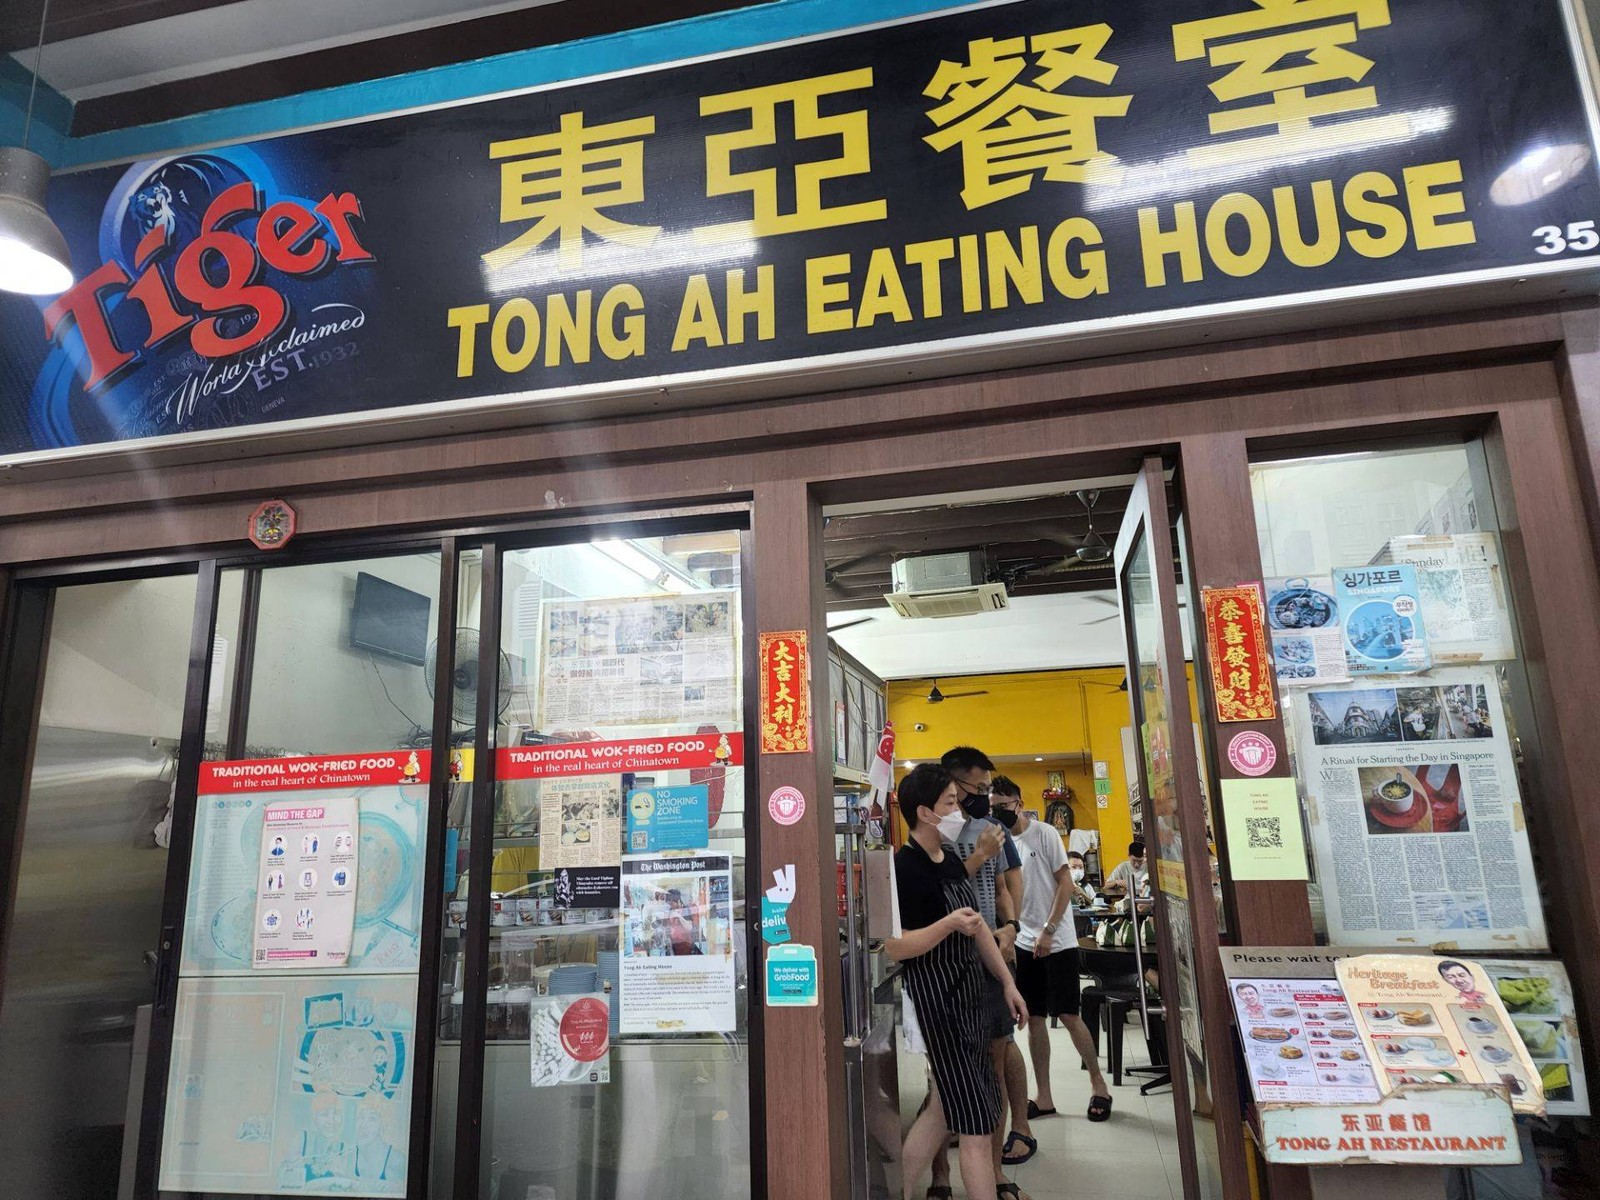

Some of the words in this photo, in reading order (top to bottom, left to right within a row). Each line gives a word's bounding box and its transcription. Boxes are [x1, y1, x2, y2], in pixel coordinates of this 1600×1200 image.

[480, 0, 1392, 271] 東亞餐室
[1531, 220, 1600, 256] 35
[447, 282, 646, 378] TONG
[671, 265, 776, 352] AH
[806, 217, 1110, 335] EATING
[1137, 160, 1477, 287] HOUSE
[44, 181, 375, 392] Tiger
[1342, 570, 1403, 588] 싱가포르
[1218, 598, 1251, 691] 恭喜發財
[772, 640, 795, 725] 大吉大利
[510, 751, 588, 763] TRADITIONAL
[592, 745, 663, 758] WOK-FRIED
[667, 741, 705, 752] FOOD
[1330, 756, 1355, 765] Ritual
[1357, 756, 1368, 764] for
[1370, 754, 1404, 765] Starting
[1405, 754, 1419, 762] the
[1421, 753, 1438, 763] Day
[1450, 752, 1494, 762] Singapore
[213, 765, 285, 777] TRADITIONAL
[289, 760, 356, 773] WOK-FRIED
[360, 758, 395, 769] FOOD
[533, 765, 543, 773] in
[546, 763, 560, 772] the
[563, 762, 582, 771] real
[584, 761, 609, 770] heart
[612, 760, 622, 768] of
[625, 757, 679, 768] Chinatown
[233, 780, 242, 788] in
[244, 777, 258, 787] the
[260, 776, 278, 786] real
[281, 776, 304, 785] heart
[306, 775, 316, 783] of
[320, 774, 370, 783] Chinatown
[657, 790, 670, 799] NO
[657, 797, 698, 807] SMOKING
[267, 811, 289, 820] MIND
[290, 810, 305, 819] THE
[306, 809, 323, 818] GAP
[657, 807, 681, 816] ZONE
[640, 862, 651, 871] The
[653, 861, 690, 872] Washington
[692, 860, 705, 869] Post
[1233, 954, 1285, 963] Please
[1287, 954, 1319, 963] wait
[774, 973, 809, 982] GrabFood
[1348, 967, 1408, 982] Heritage
[1370, 979, 1440, 990] Breakfast
[1341, 1113, 1432, 1132] 东亚餐馆
[1276, 1135, 1331, 1151] TONG
[1337, 1136, 1364, 1151] AH
[1371, 1135, 1507, 1151] RESTAURANT
